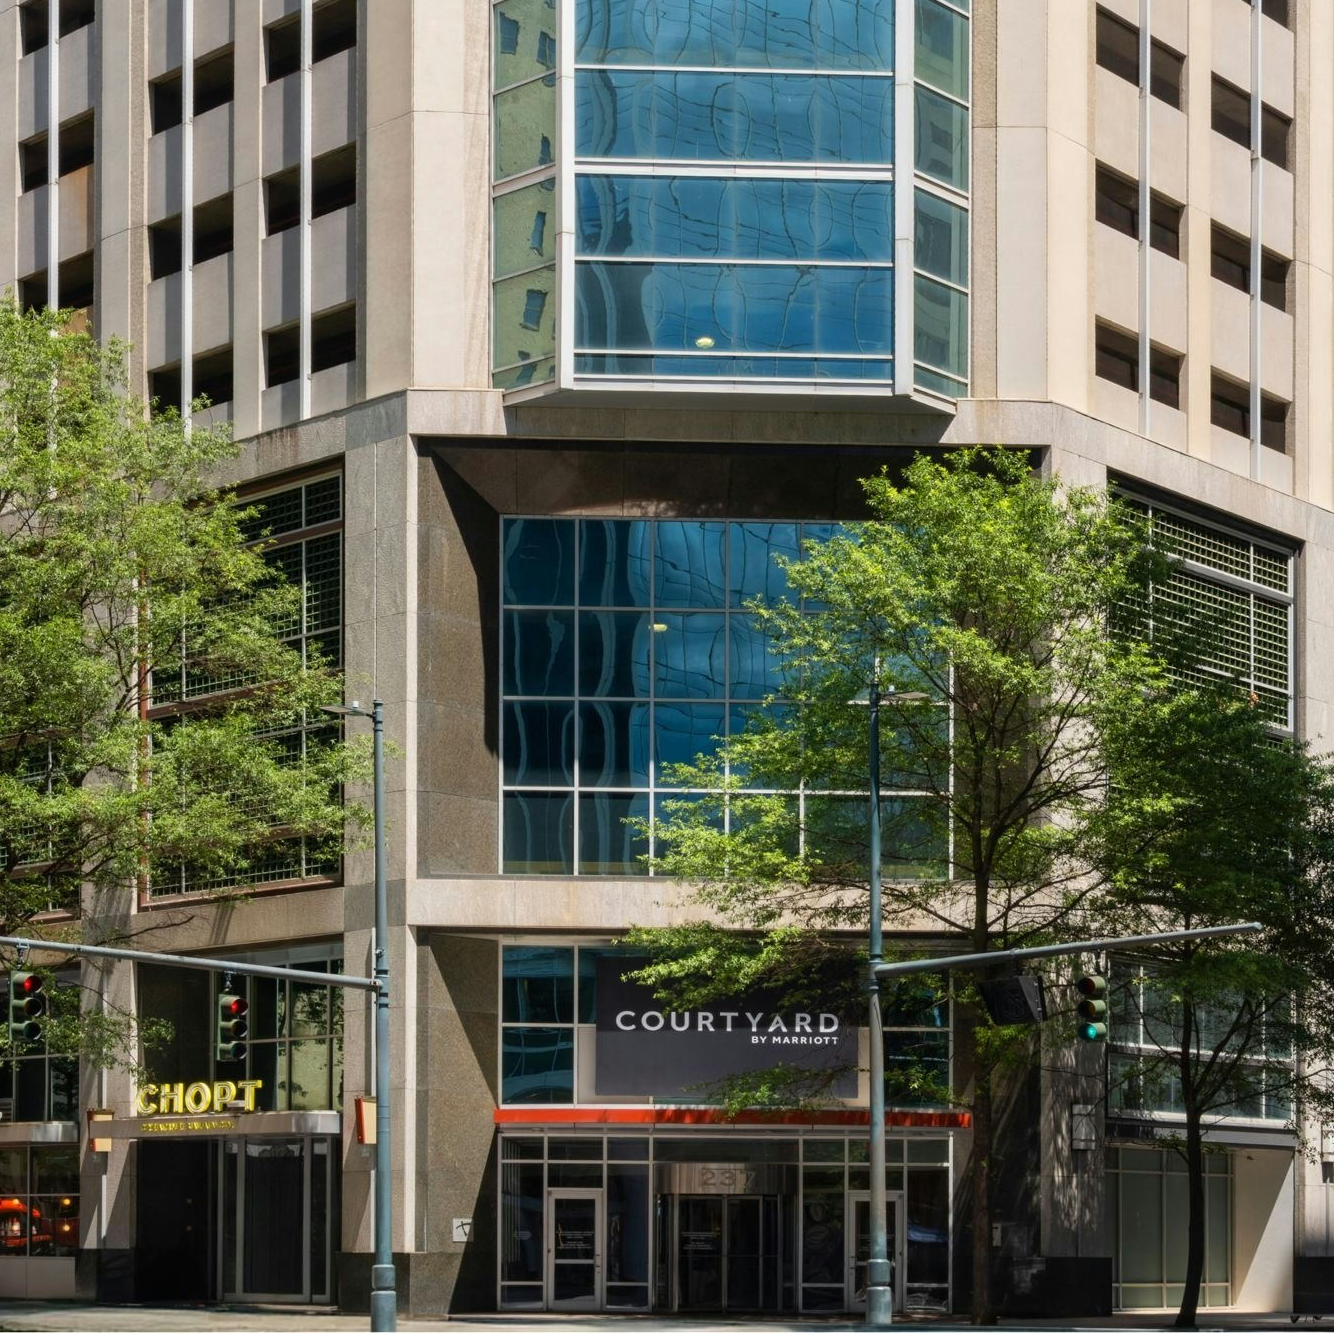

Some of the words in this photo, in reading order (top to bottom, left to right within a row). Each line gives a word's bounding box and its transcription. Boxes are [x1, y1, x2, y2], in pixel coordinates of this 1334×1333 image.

[616, 1010, 839, 1033] COURTYARD
[752, 1036, 767, 1044] BY
[772, 1036, 839, 1045] MARRIOTT
[137, 1079, 263, 1115] CHOPT
[701, 1169, 756, 1188] 237
